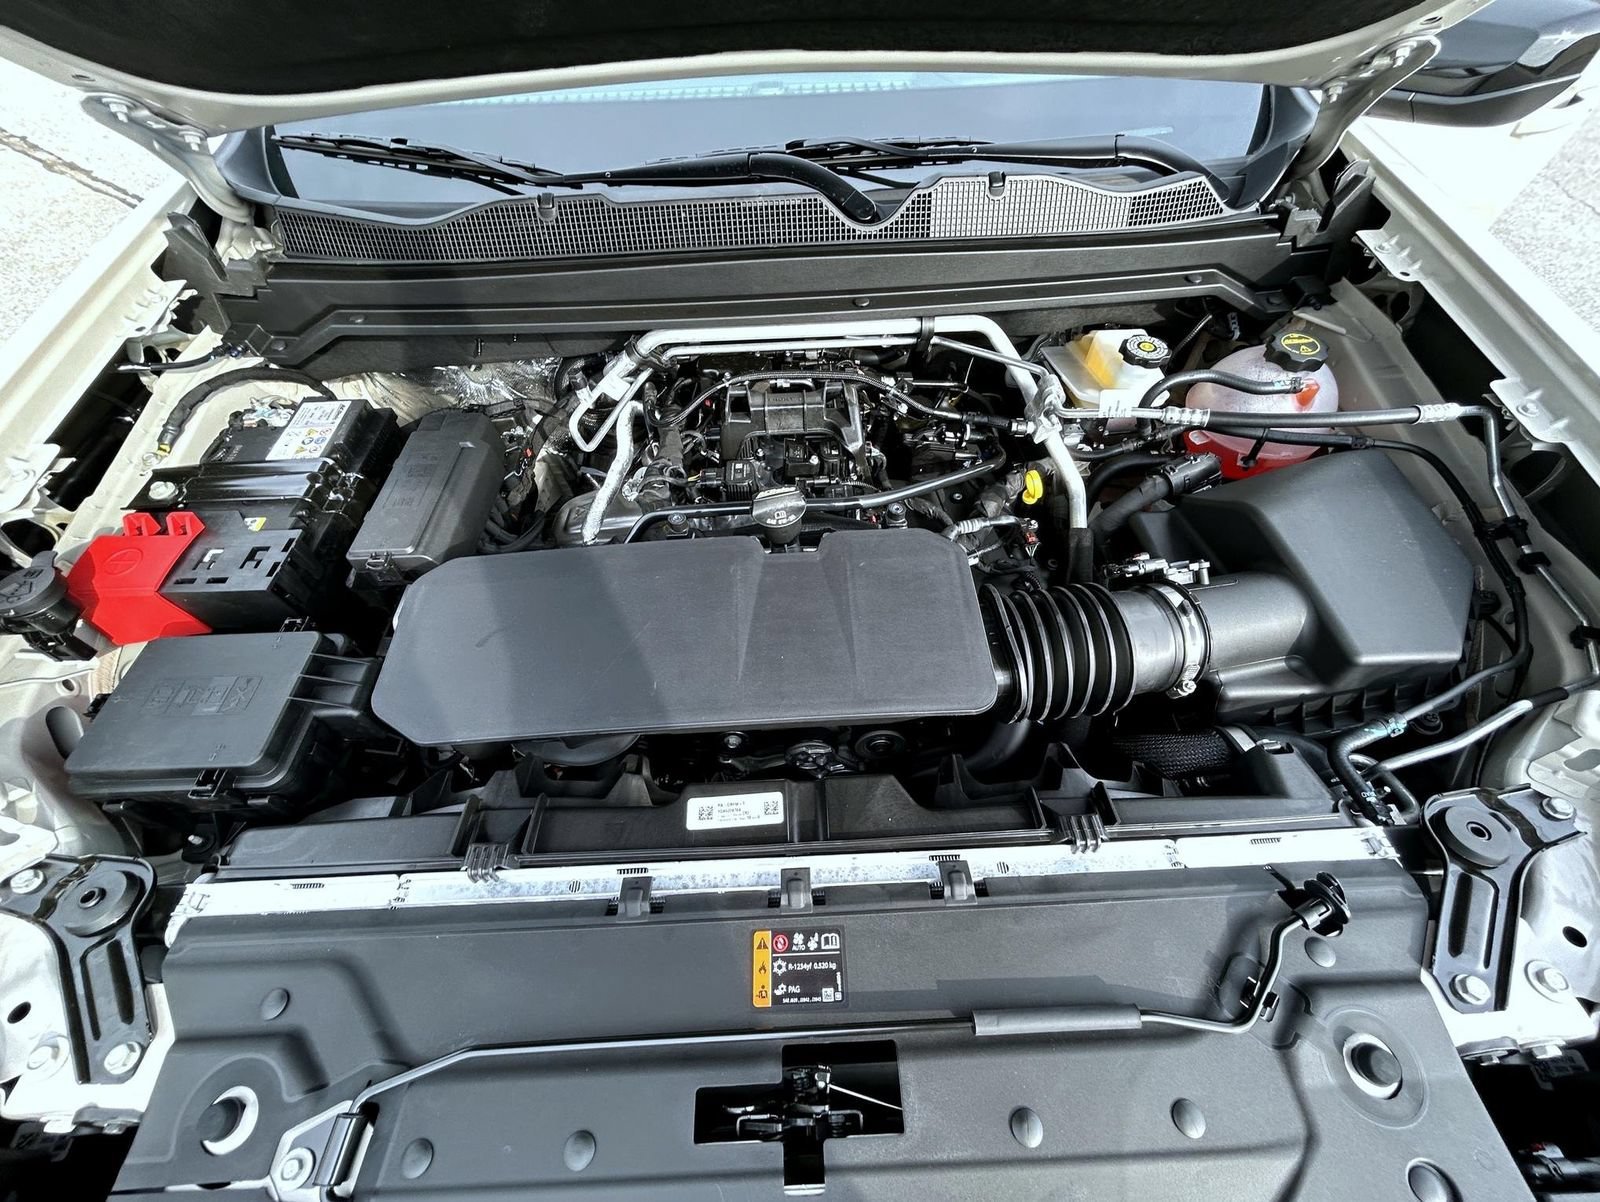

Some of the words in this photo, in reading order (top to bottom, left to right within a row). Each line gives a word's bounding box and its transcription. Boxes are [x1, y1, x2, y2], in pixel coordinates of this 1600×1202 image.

[788, 962, 812, 971] R-1234yf
[829, 961, 836, 970] kg
[788, 985, 801, 993] PAG
